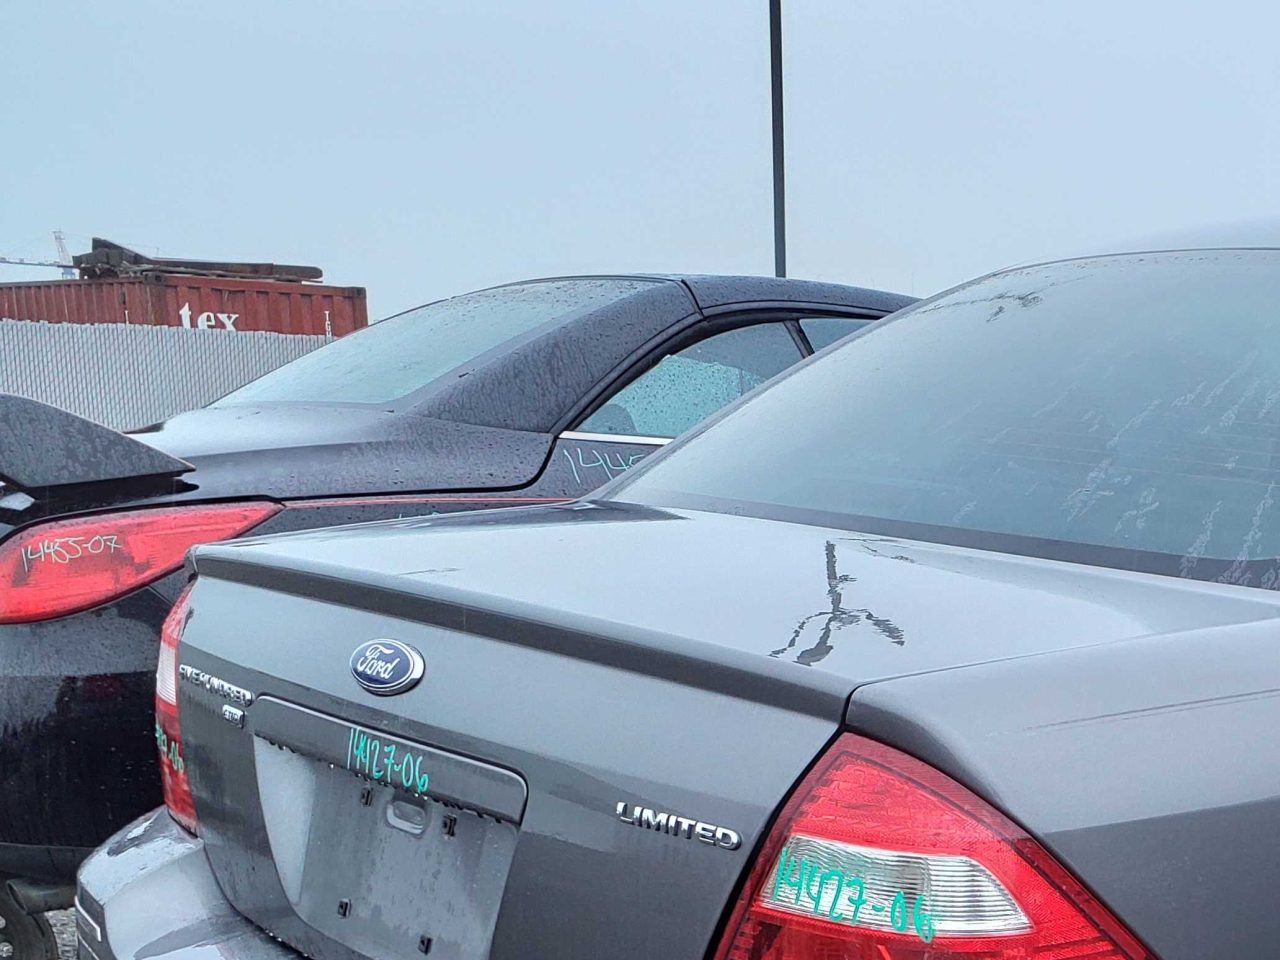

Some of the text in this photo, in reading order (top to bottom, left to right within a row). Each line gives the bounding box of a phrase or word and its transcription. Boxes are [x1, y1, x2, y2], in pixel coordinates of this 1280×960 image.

[357, 644, 402, 680] Ford
[347, 727, 429, 794] 14427-06
[616, 801, 742, 851] LIMITED
[771, 847, 936, 944] 14427-06
